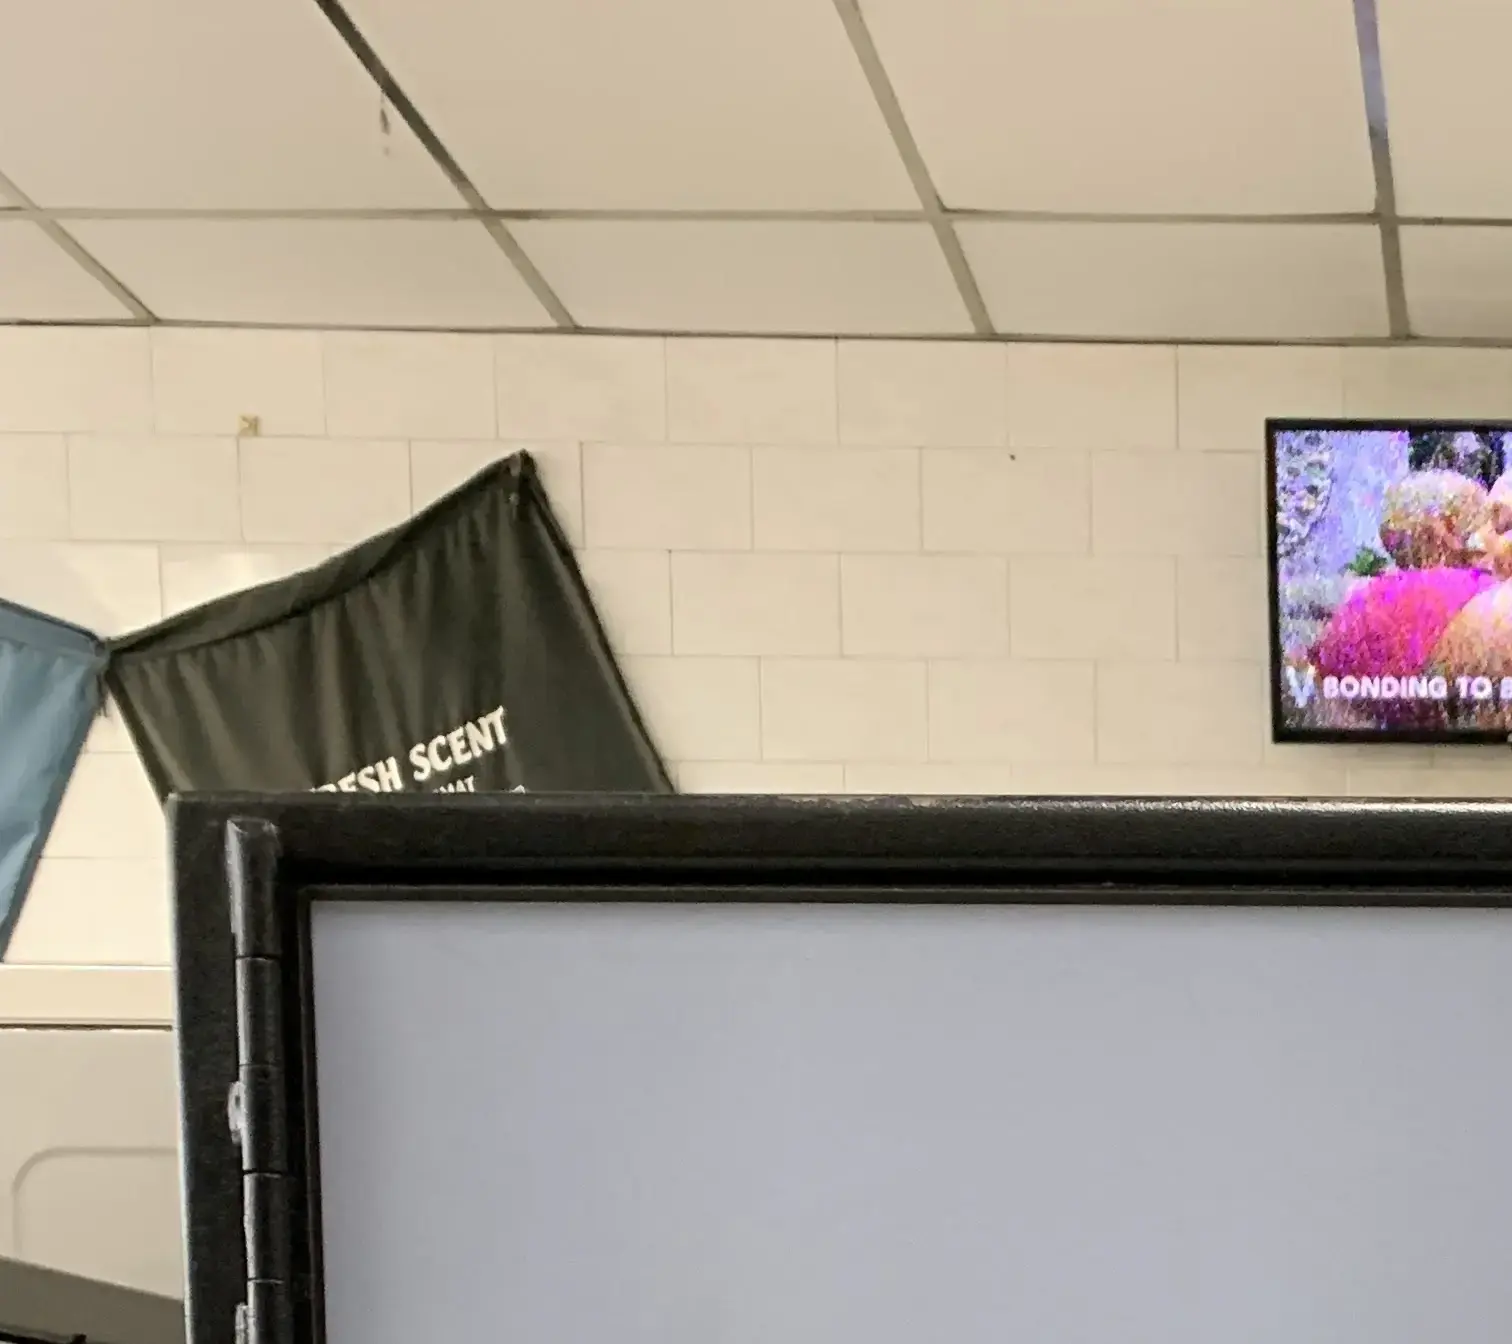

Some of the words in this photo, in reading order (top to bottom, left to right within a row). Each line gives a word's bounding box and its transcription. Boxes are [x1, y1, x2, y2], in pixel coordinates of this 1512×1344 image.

[1322, 676, 1447, 700] BONDING
[1457, 676, 1492, 700] TO
[408, 705, 508, 782] SCENT
